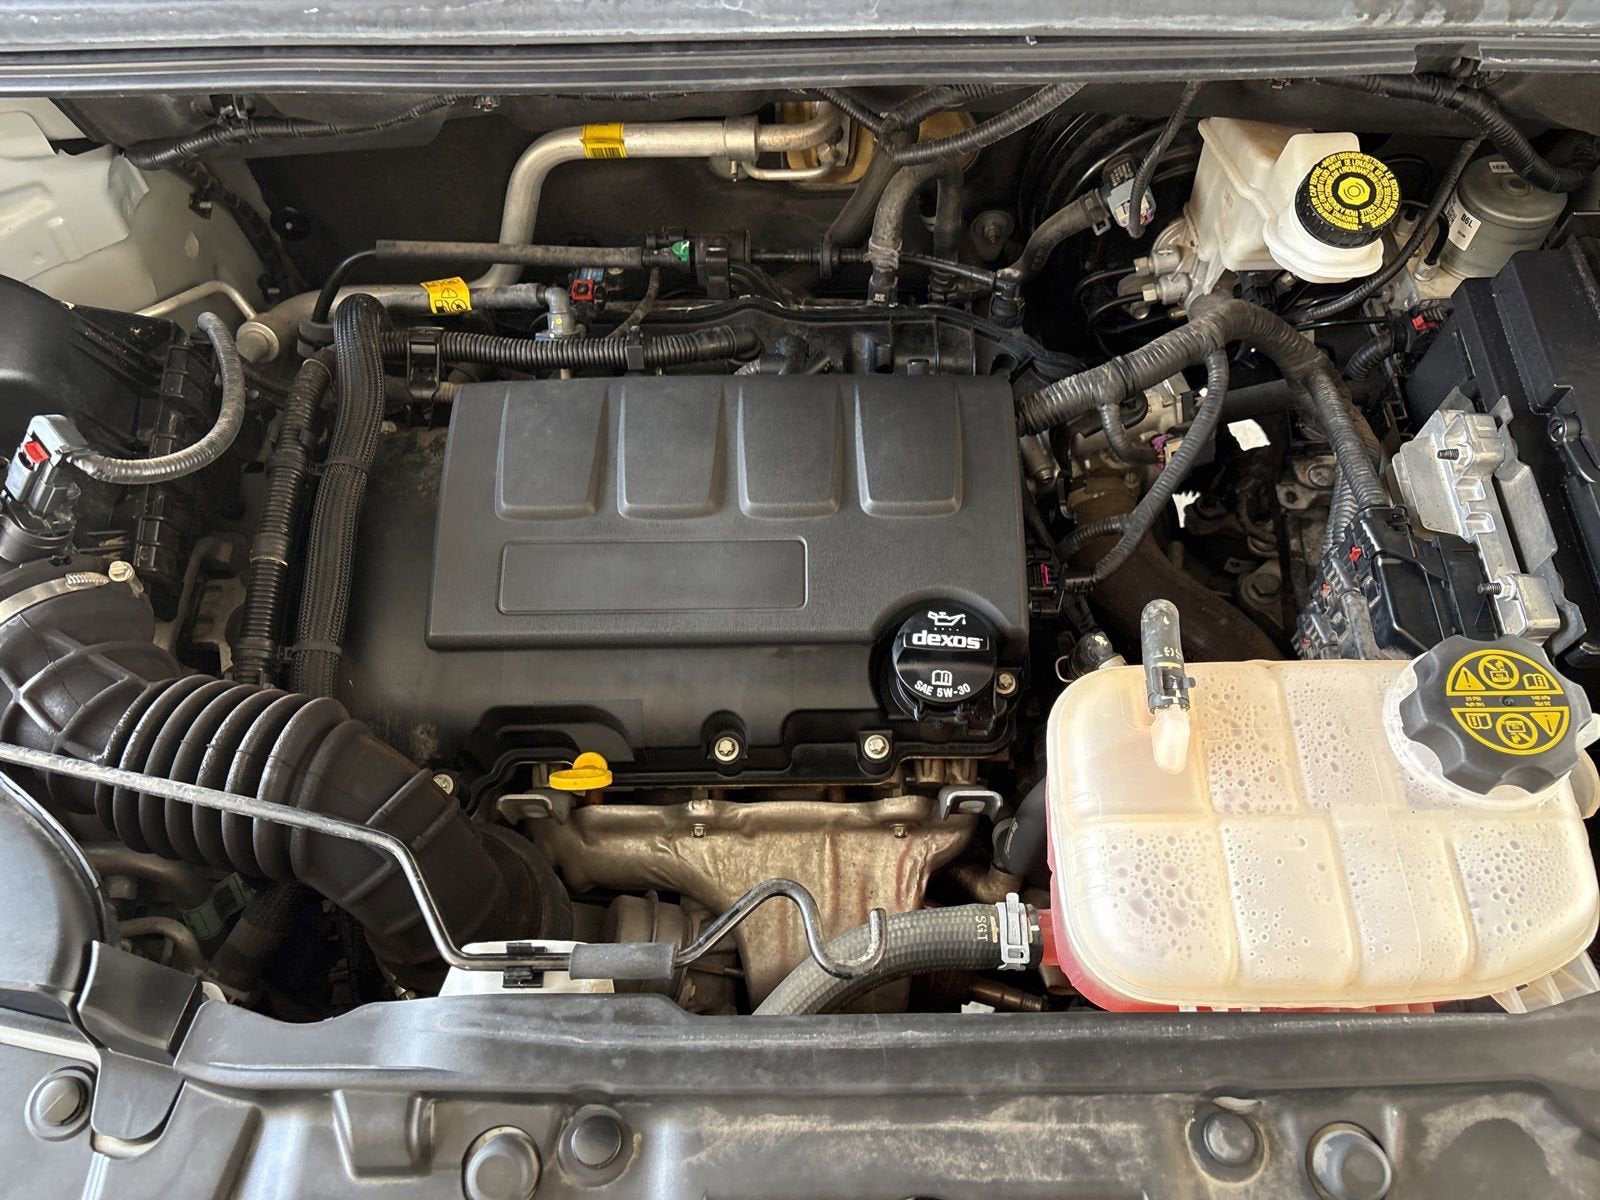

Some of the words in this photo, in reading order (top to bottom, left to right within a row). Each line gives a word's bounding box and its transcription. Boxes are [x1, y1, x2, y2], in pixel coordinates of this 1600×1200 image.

[1309, 185, 1317, 196] CAP
[1460, 213, 1472, 228] B6L
[912, 630, 980, 650] dexos
[914, 680, 934, 696] SAE
[936, 683, 970, 698] 5W-30
[974, 915, 988, 942] SGT
